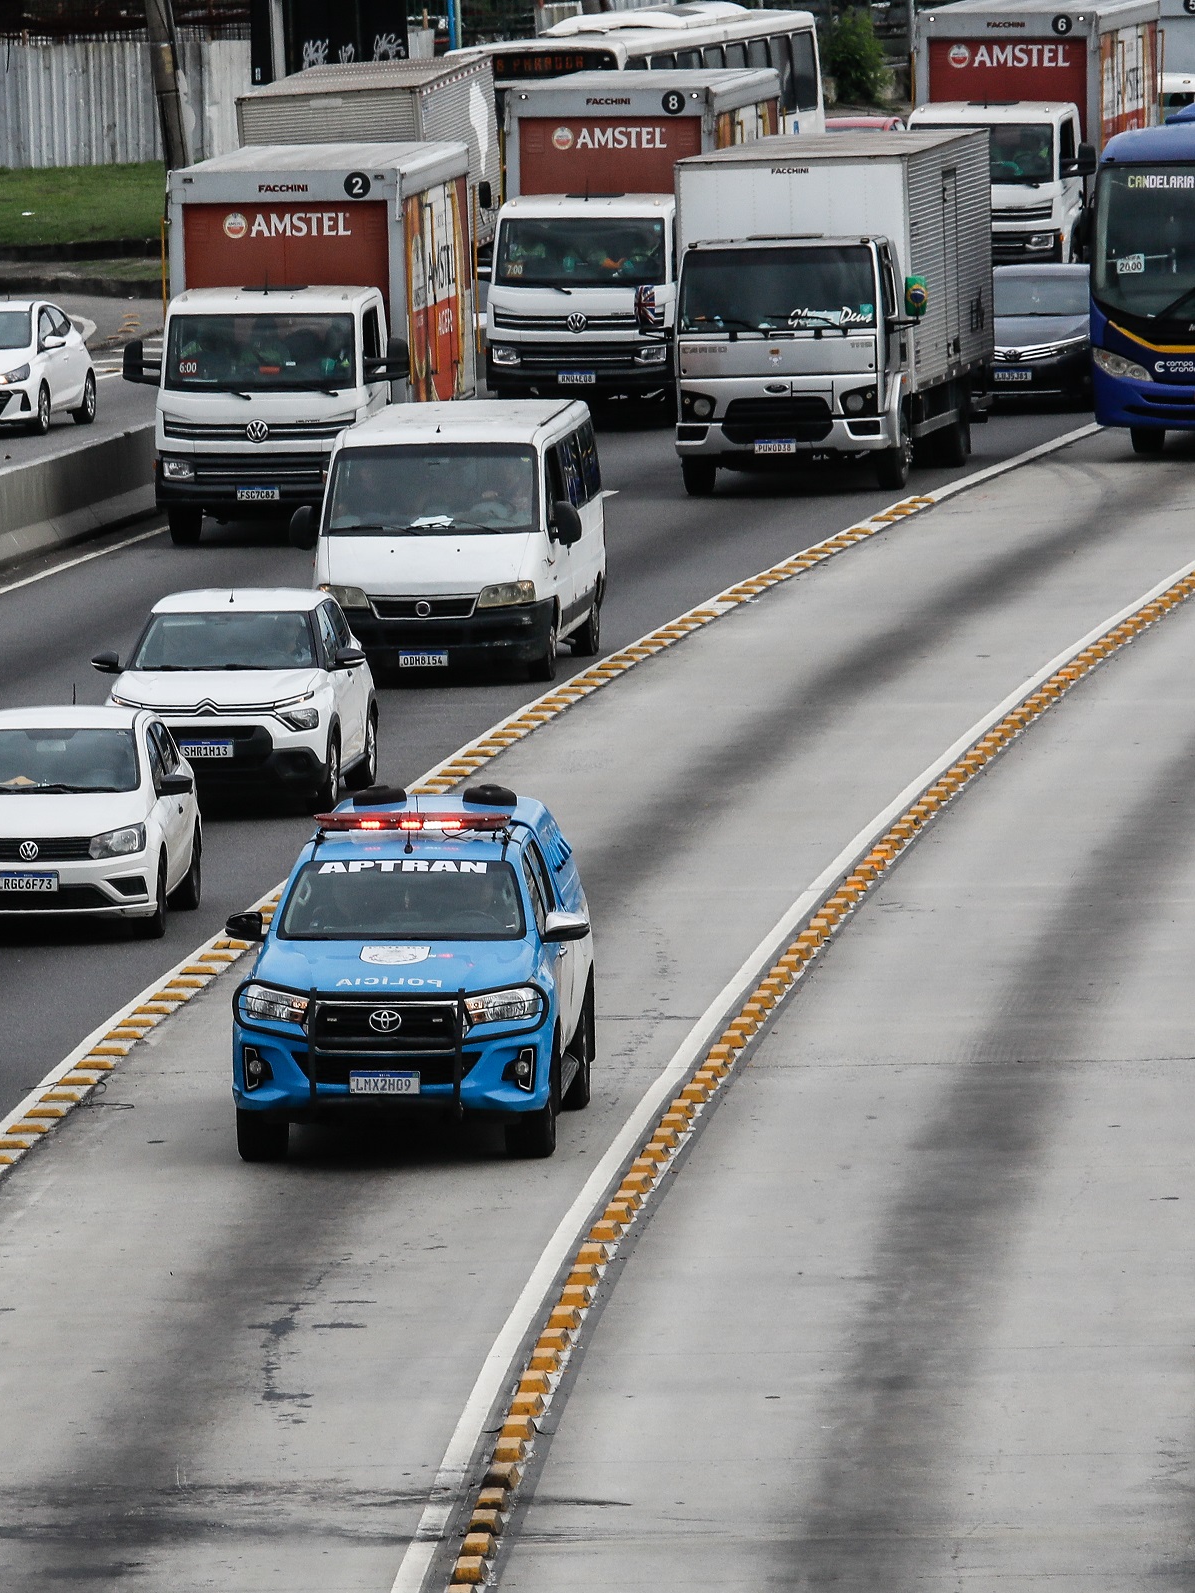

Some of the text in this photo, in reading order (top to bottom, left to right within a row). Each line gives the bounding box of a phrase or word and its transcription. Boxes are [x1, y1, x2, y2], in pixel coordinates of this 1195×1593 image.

[1058, 18, 1067, 32] 6
[973, 44, 1070, 68] AMSTEL
[586, 98, 631, 106] FACCHINI
[668, 95, 679, 111] 8
[575, 126, 667, 150] AMSTEL
[258, 184, 308, 193] FACCHINI
[351, 177, 363, 194] 2
[1127, 175, 1194, 189] CANDELARIA
[250, 212, 352, 237] AMSTEL
[179, 362, 197, 374] 6:00
[184, 746, 228, 757] SHR1H13
[317, 860, 489, 875] APTRAN
[4, 878, 53, 890] RGC6F73
[355, 1078, 411, 1092] LMX2H09
